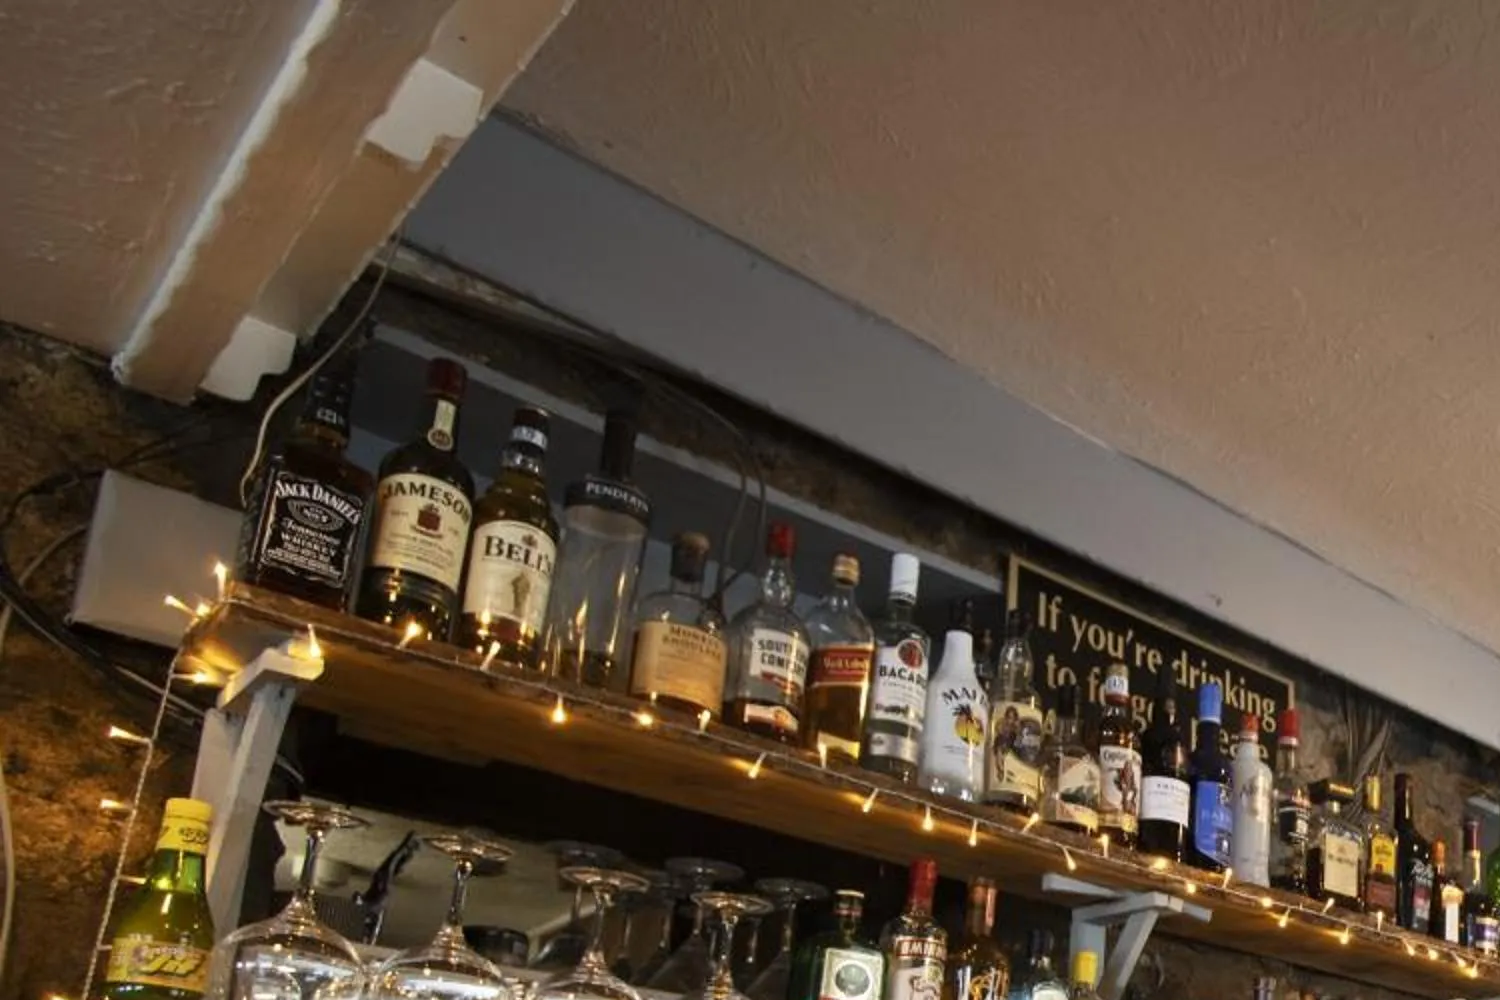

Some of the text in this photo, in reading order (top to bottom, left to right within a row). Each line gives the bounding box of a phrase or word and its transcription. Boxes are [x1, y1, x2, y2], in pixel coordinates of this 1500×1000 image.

[276, 480, 310, 498] JACK
[382, 481, 470, 524] JAMESON
[1037, 591, 1063, 633] If
[1070, 612, 1164, 675] you're
[879, 664, 928, 690] BACARD
[1046, 654, 1078, 690] to
